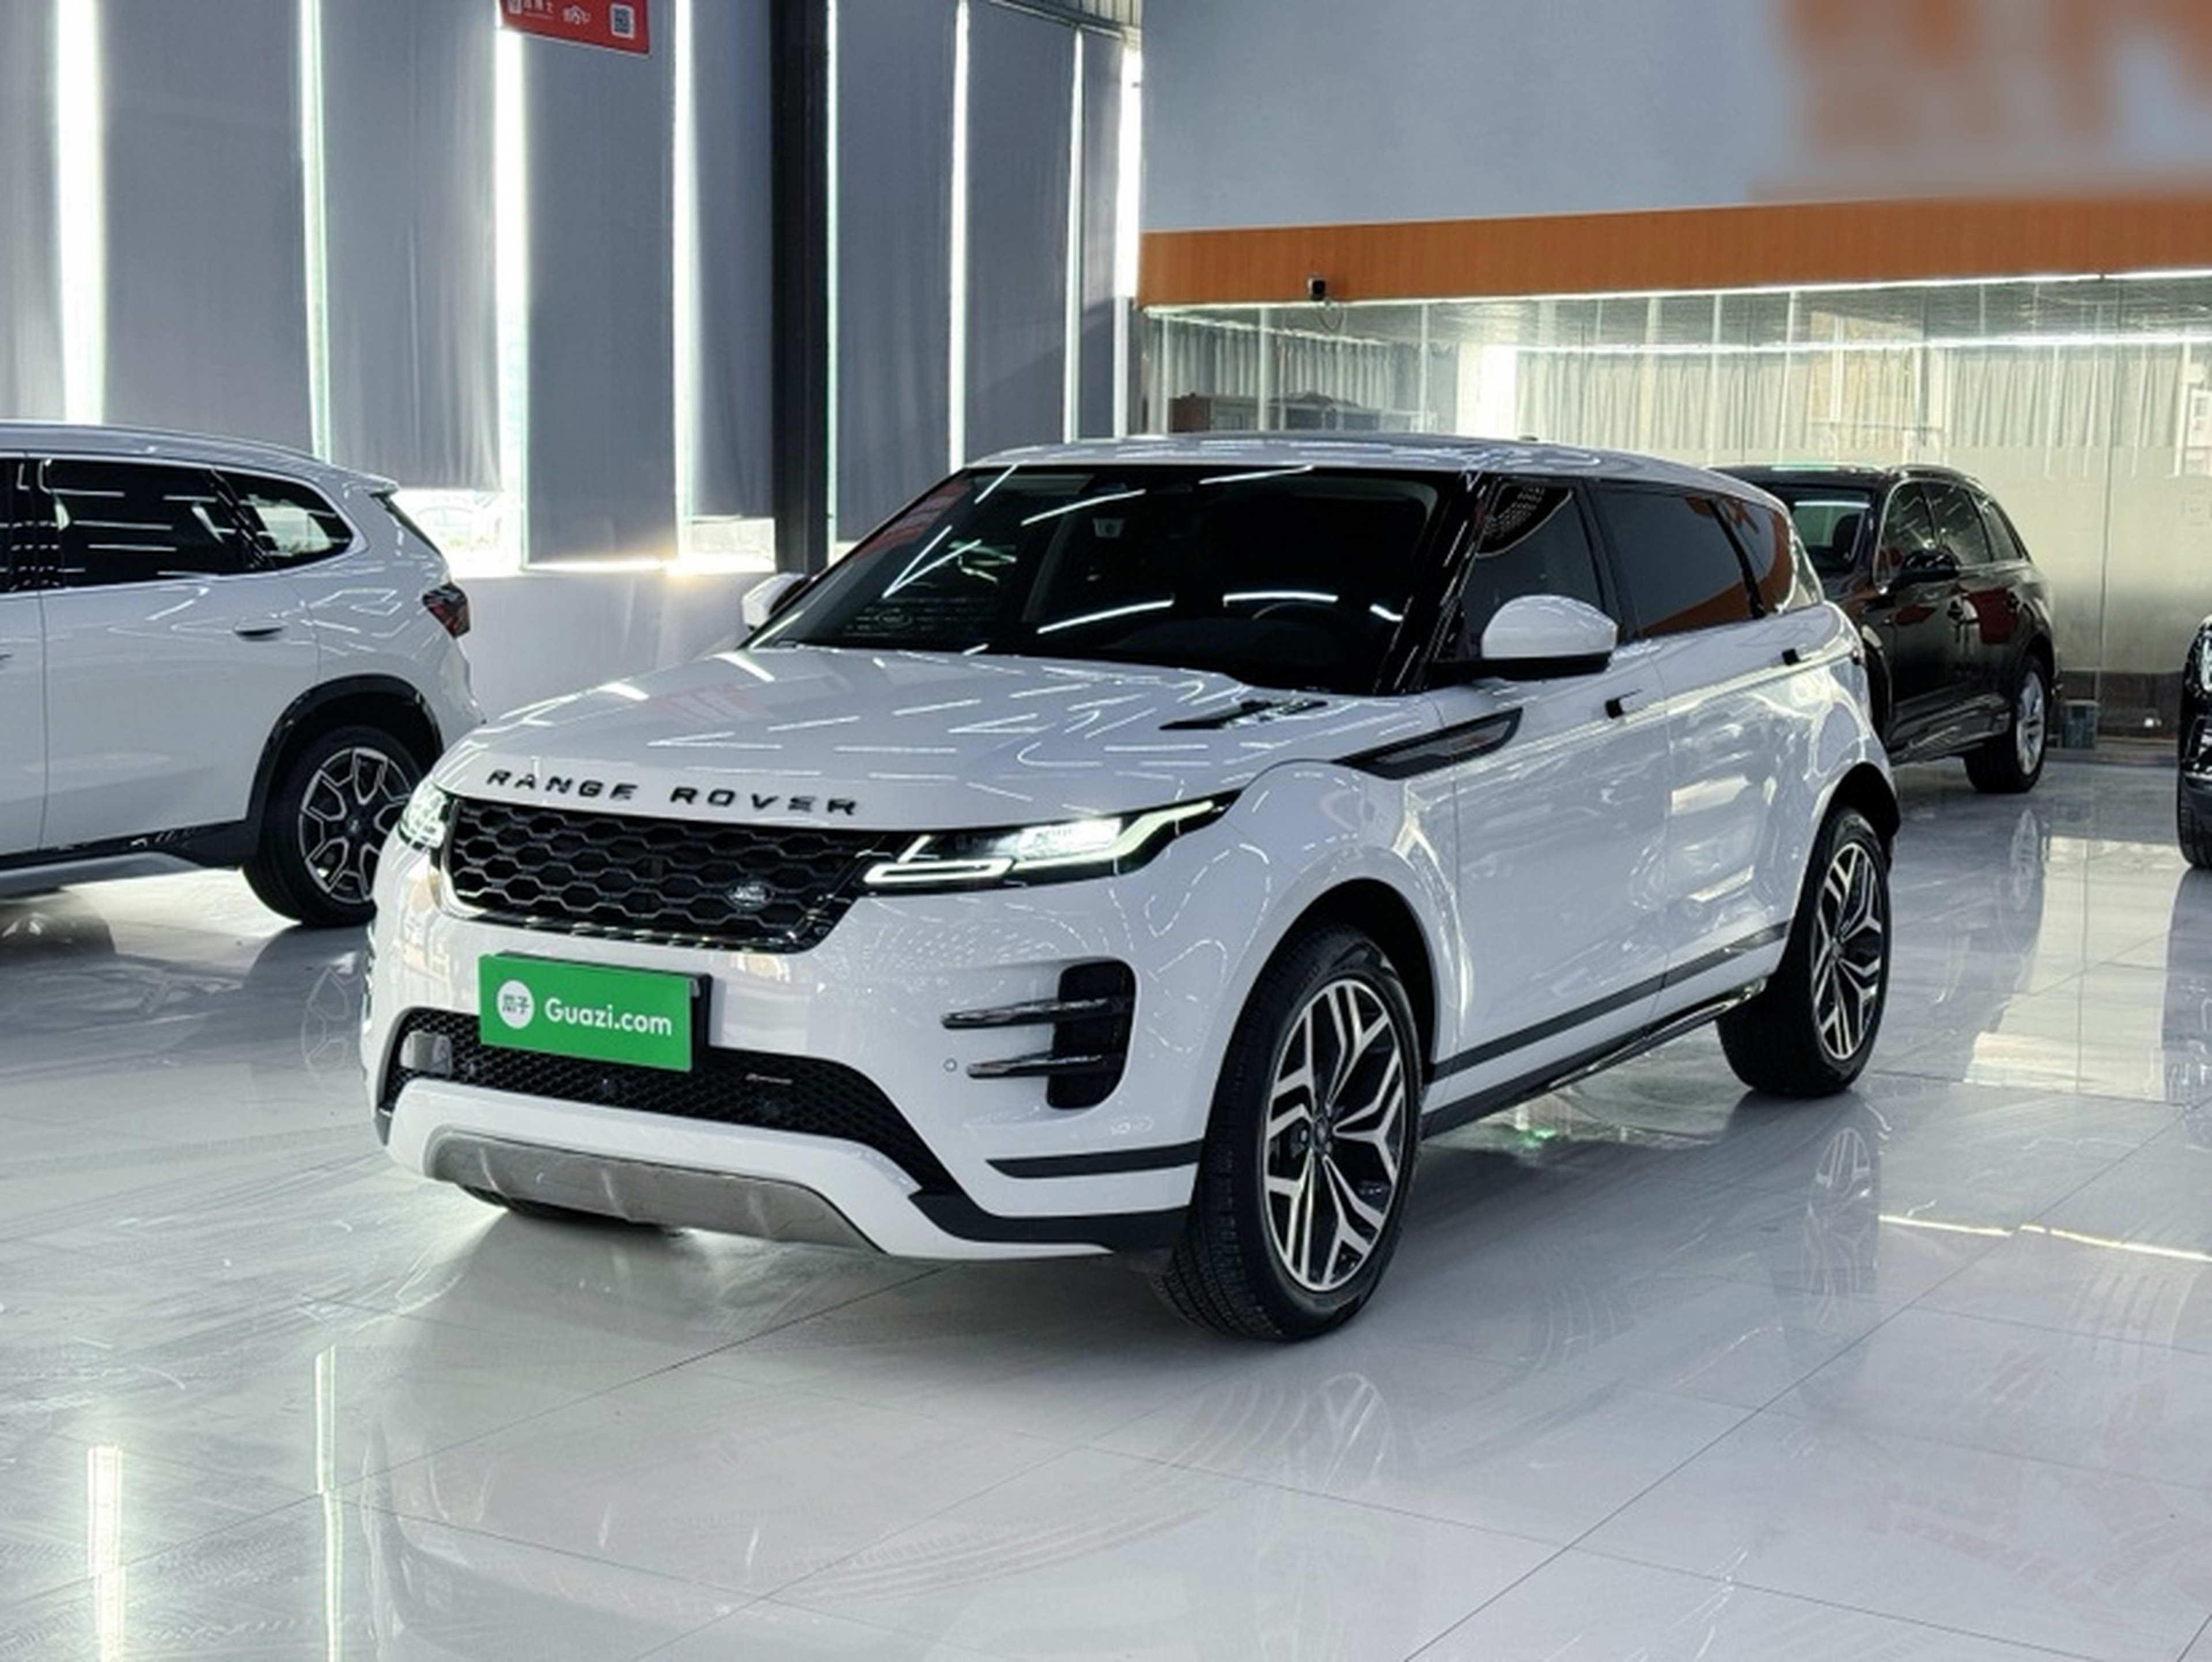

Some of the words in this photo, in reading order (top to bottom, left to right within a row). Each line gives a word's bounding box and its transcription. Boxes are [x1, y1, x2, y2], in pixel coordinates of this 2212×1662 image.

[486, 769, 638, 800] RANGE
[670, 786, 857, 816] ROVER
[544, 997, 673, 1036] Guazi.com
